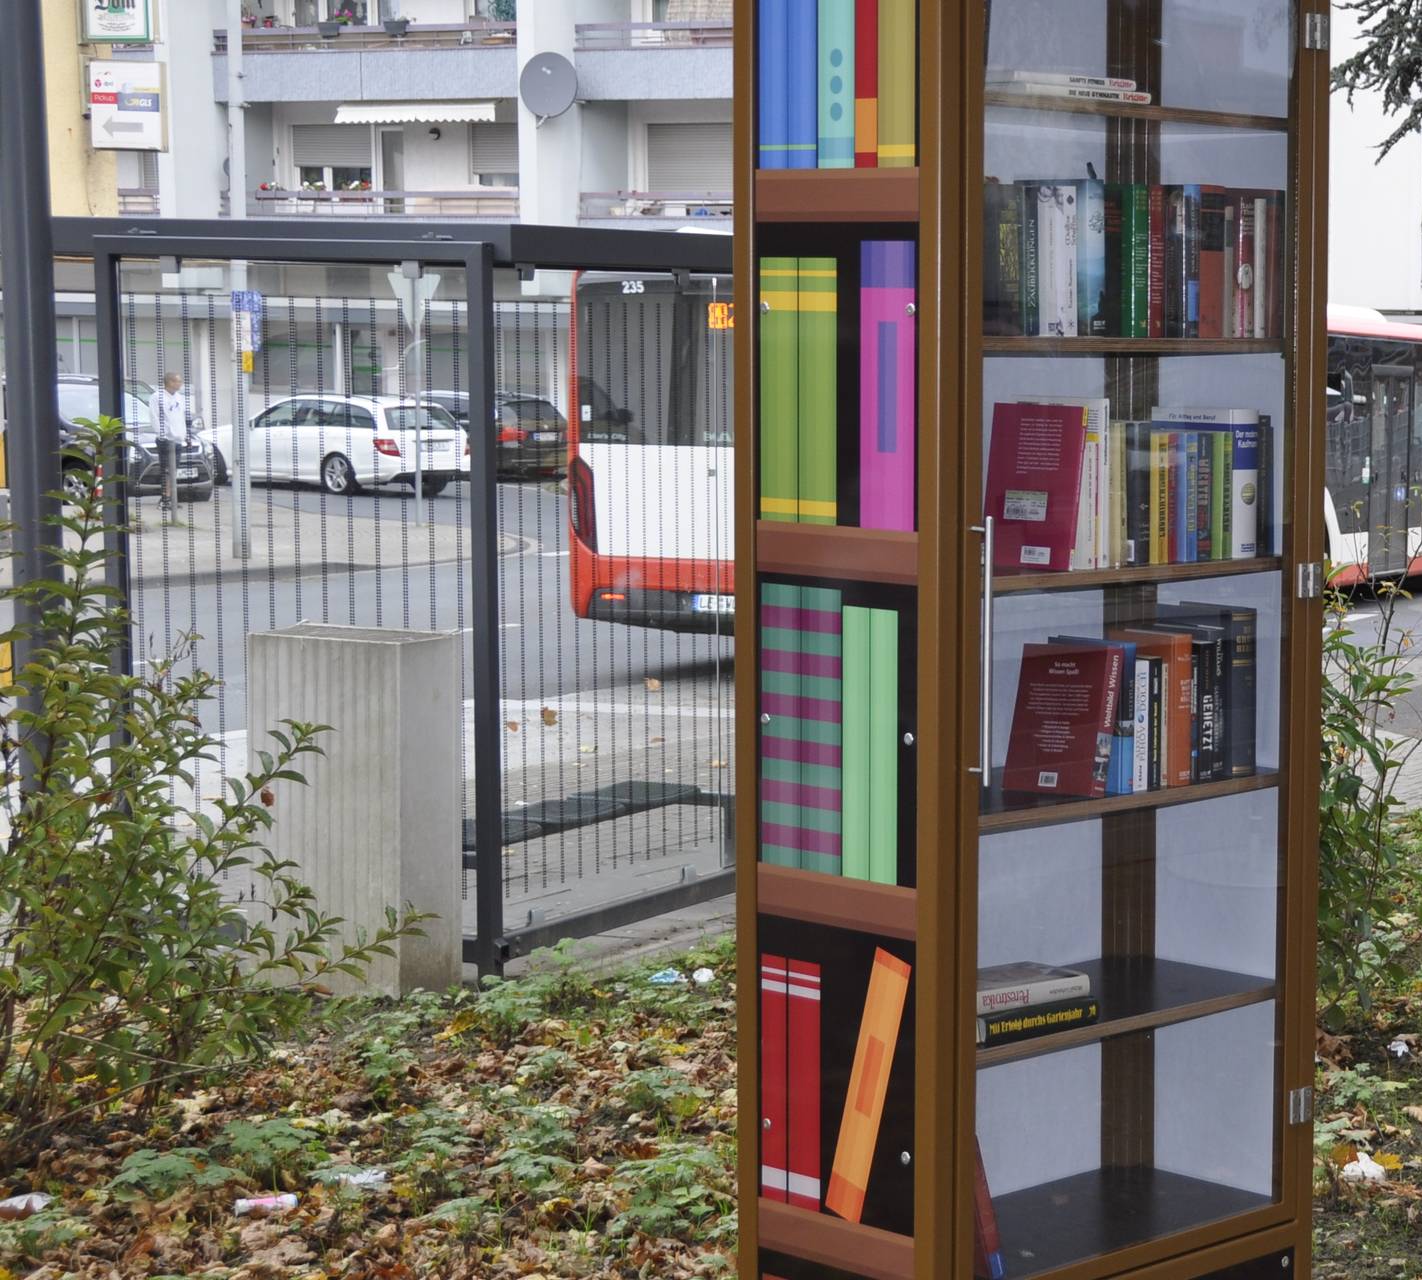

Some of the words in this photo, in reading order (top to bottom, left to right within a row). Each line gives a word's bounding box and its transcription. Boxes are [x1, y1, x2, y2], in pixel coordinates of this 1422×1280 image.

[621, 280, 645, 294] 235
[1109, 655, 1119, 688] Wissen
[1104, 691, 1115, 728] Weltbild
[1202, 694, 1213, 751] GEHETZT
[982, 989, 1030, 1009] Perestroika
